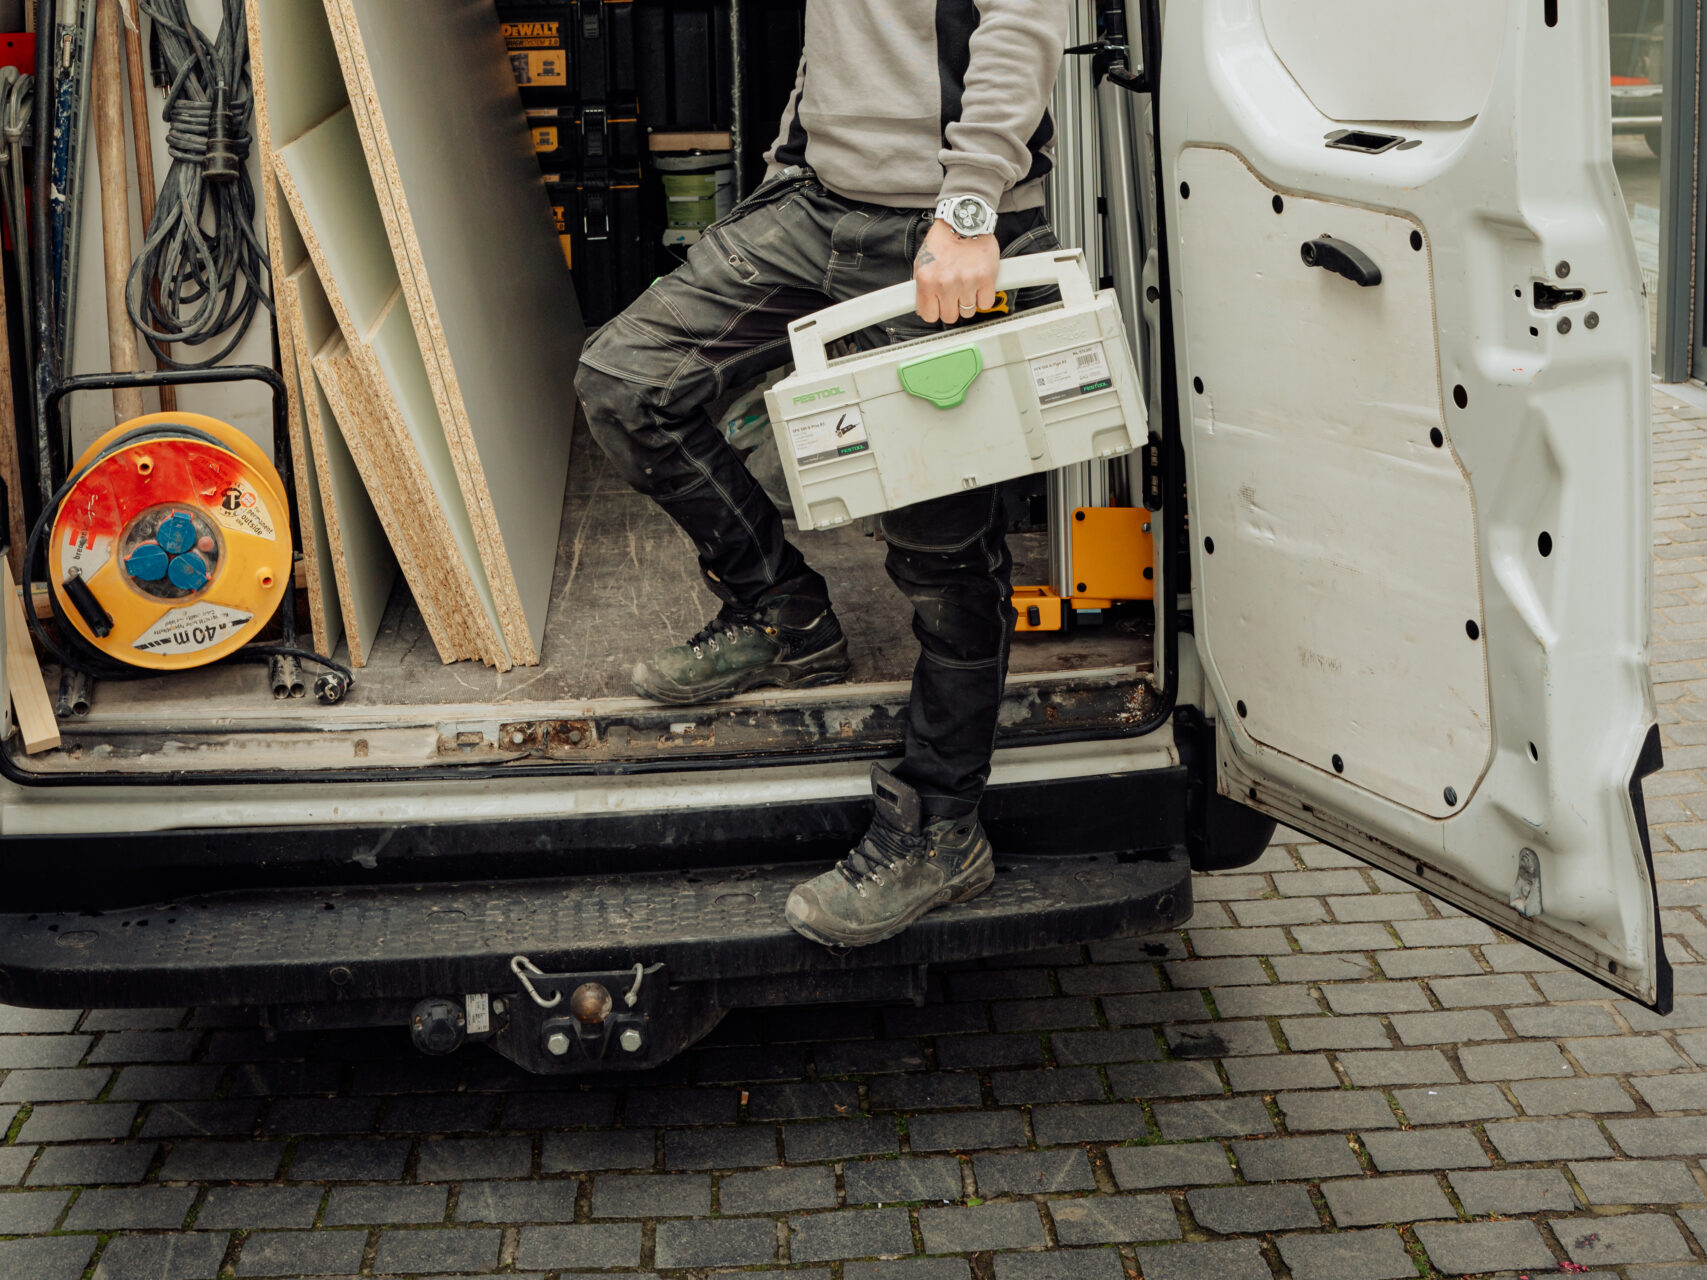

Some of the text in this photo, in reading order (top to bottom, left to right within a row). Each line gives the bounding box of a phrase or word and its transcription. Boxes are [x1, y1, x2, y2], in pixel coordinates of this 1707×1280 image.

[792, 386, 846, 405] FESTOOL
[1083, 381, 1109, 392] FESTOOL
[840, 444, 866, 454] FESTOOL
[241, 514, 263, 535] outside
[173, 624, 217, 645] 40 m
